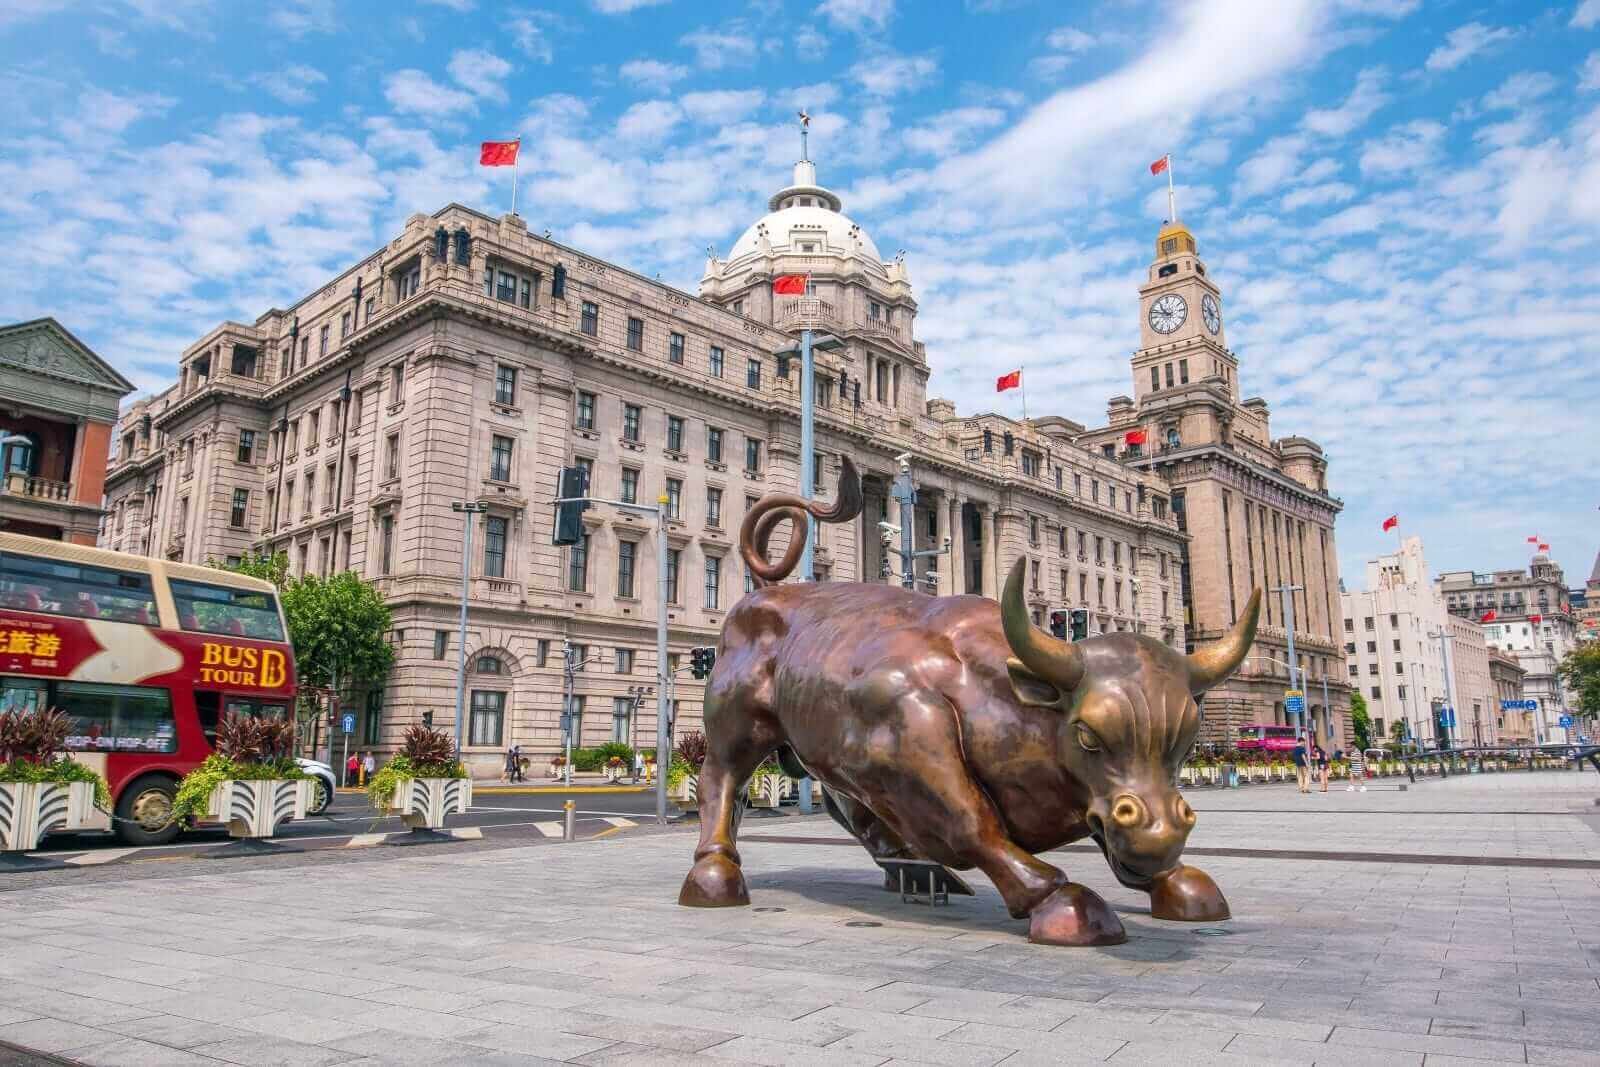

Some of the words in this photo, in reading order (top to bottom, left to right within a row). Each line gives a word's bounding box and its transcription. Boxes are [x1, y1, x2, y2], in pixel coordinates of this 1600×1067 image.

[200, 643, 258, 668] BUS
[200, 668, 256, 686] TOUR
[64, 735, 114, 748] HOP-ON
